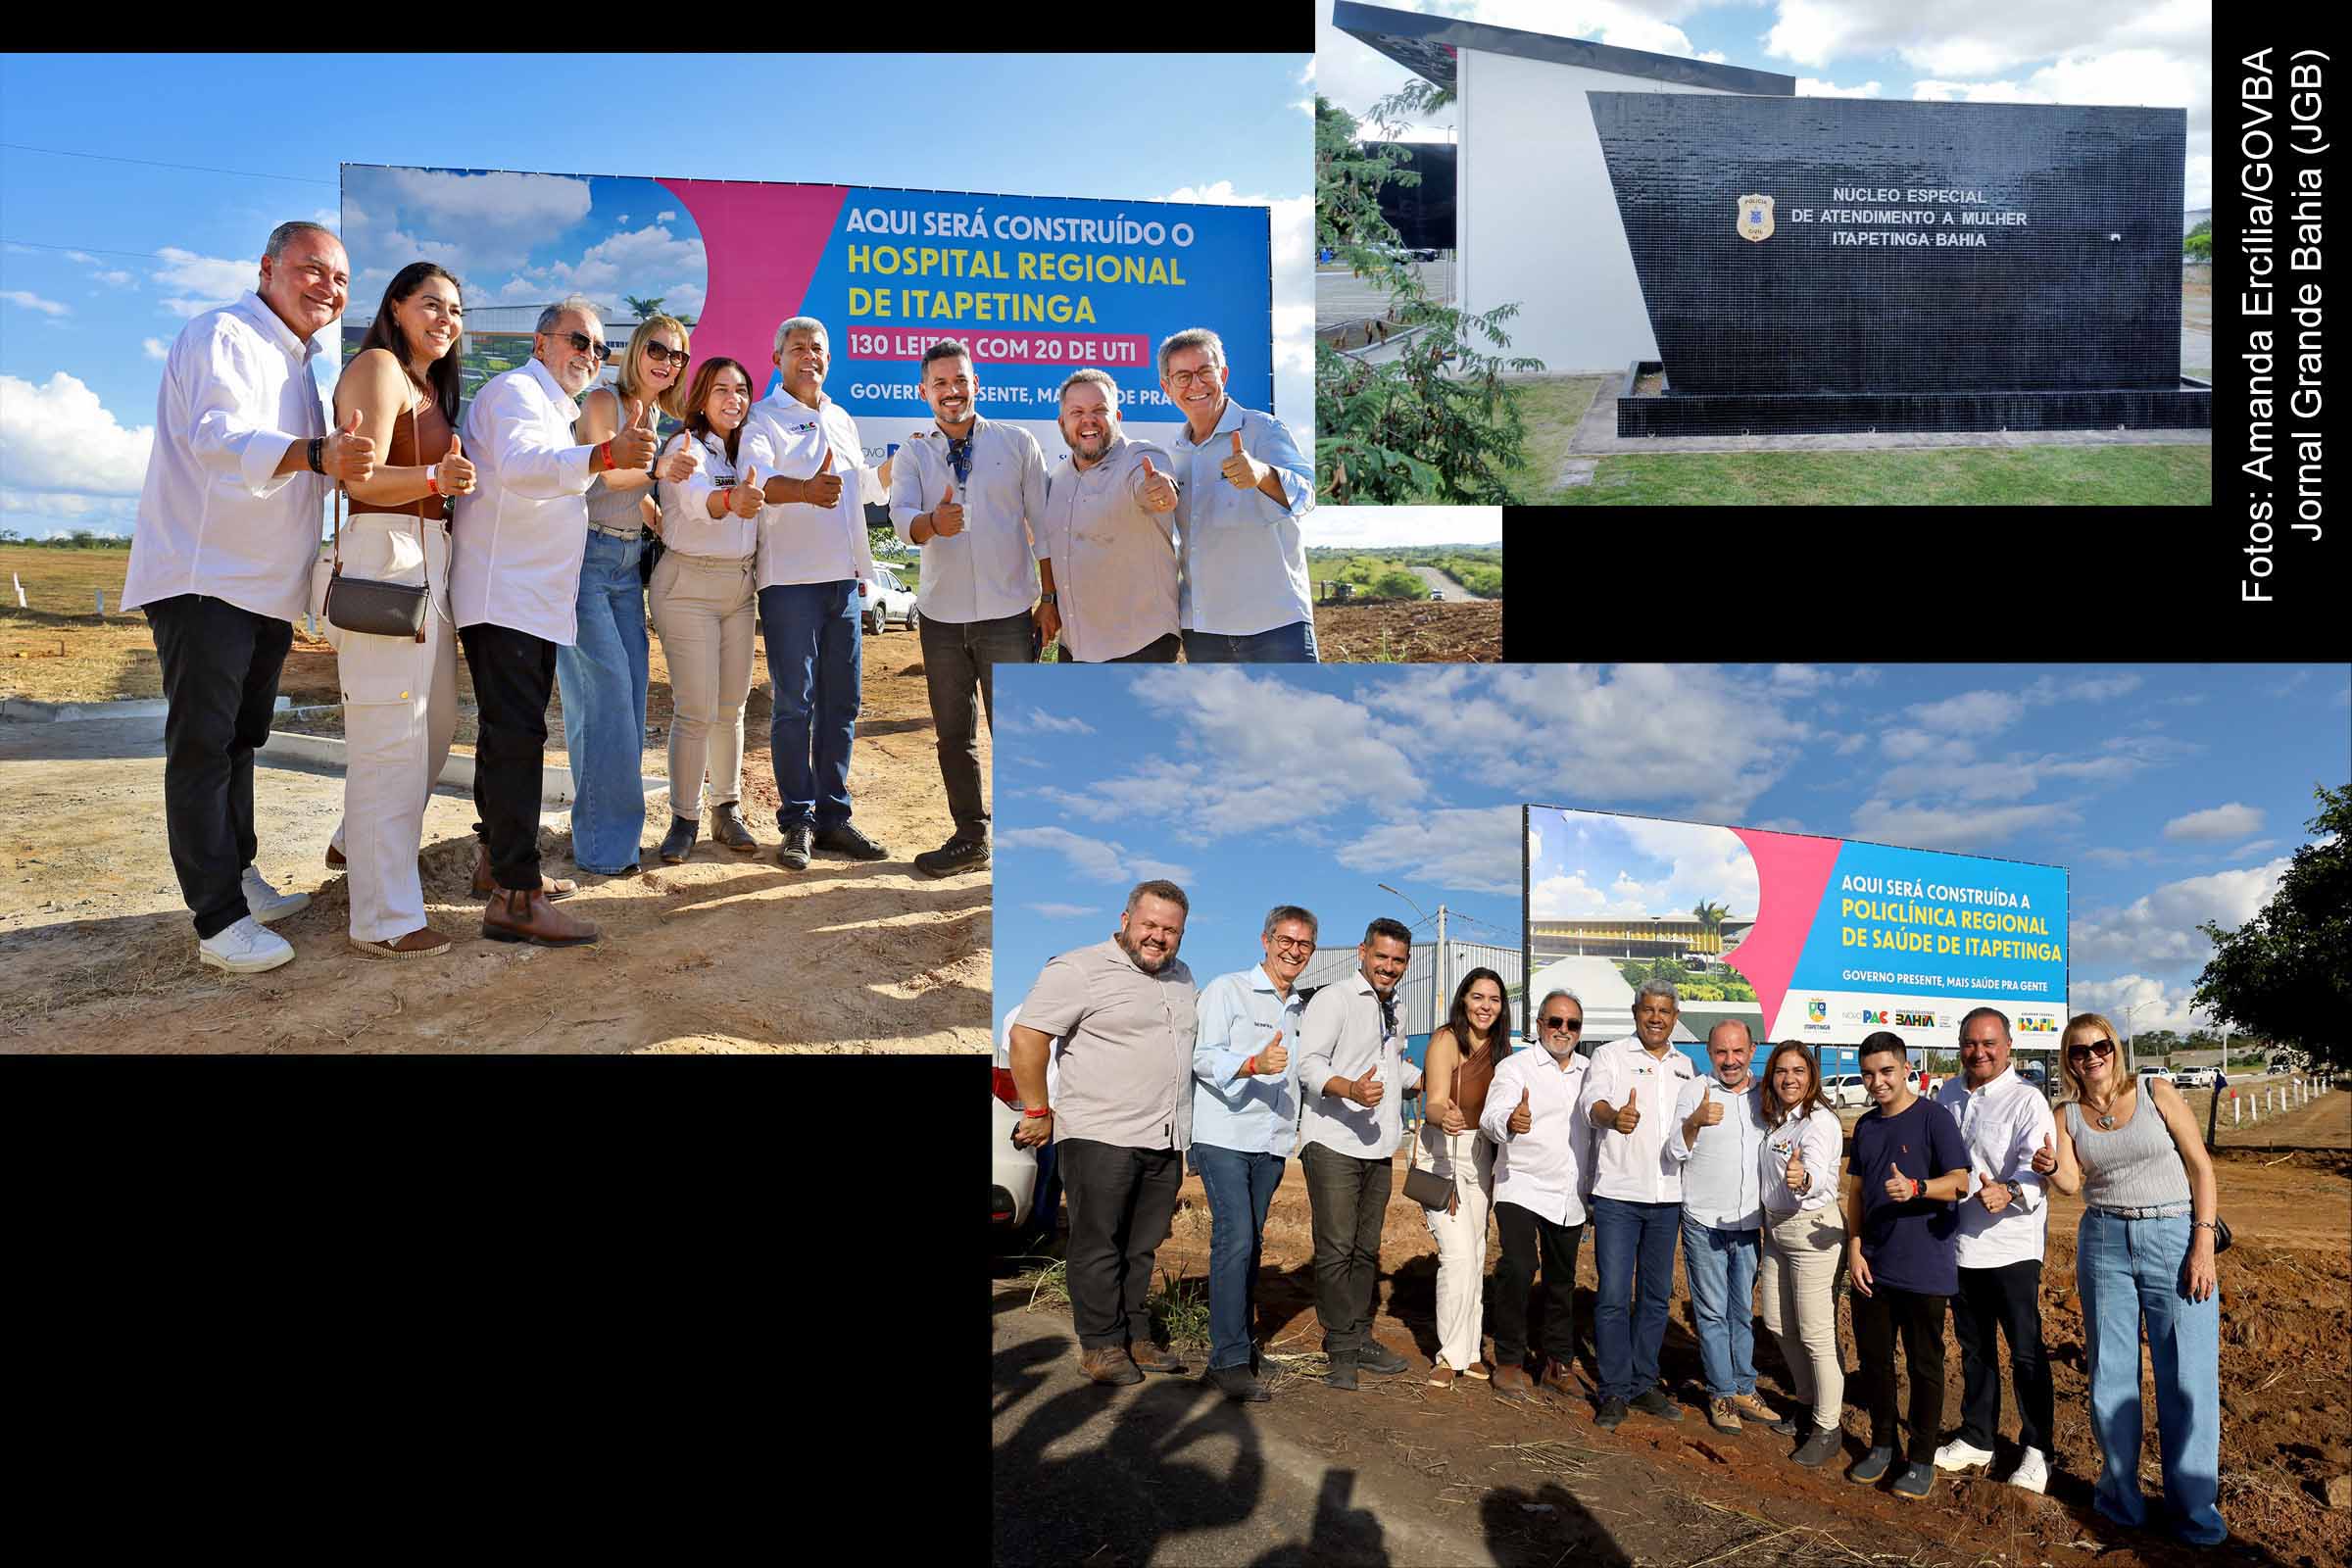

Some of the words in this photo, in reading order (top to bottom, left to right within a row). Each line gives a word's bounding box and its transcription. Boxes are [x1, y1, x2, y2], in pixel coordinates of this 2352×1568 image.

[1907, 189, 1986, 203] ESPECIAL
[846, 208, 916, 235] AQUI
[923, 207, 989, 238] SERÁ
[994, 214, 1166, 246] CONSTRUÍDO
[1171, 222, 1195, 247] O
[1791, 209, 1813, 222] DE
[1820, 210, 1936, 224] ATENDIMENTO
[1942, 212, 1954, 224] A
[1962, 212, 2027, 225] MULHER
[849, 244, 1009, 279] HOSPITAL
[1018, 251, 1186, 285] REGIONAL
[849, 287, 892, 318] DE
[902, 289, 1097, 323] ITAPETINGA
[851, 334, 888, 355] 130
[895, 335, 969, 356] LEIT
[976, 338, 1028, 359] COM
[1034, 340, 1062, 360] 20
[1068, 341, 1098, 361] DE
[1103, 342, 1136, 362] UTI
[851, 383, 919, 400] GOVER
[1037, 389, 1060, 403] MA
[1841, 875, 1883, 894] AQUI
[1886, 878, 1924, 899] SERÁ
[1927, 884, 2018, 907] CONSTRUÍDA
[2021, 895, 2031, 909] A
[1841, 899, 1957, 927] POLICLÍNICA
[1962, 910, 2049, 935] REGIONAL
[1842, 927, 1867, 947] DE
[1873, 926, 1933, 953] SAÚDE
[1937, 935, 1961, 956] DE
[1965, 938, 2062, 962] ITAPETINGA
[1842, 969, 1895, 983] GOVERNO
[1897, 973, 1945, 988] PRESENTE,
[1947, 976, 1969, 988] MAIS
[1971, 976, 1999, 989] SAÚDE
[2001, 980, 2019, 991] PRA
[2020, 981, 2048, 992] GENTE
[1862, 1009, 1888, 1025] PAC
[1895, 1014, 1935, 1027] BAHIA
